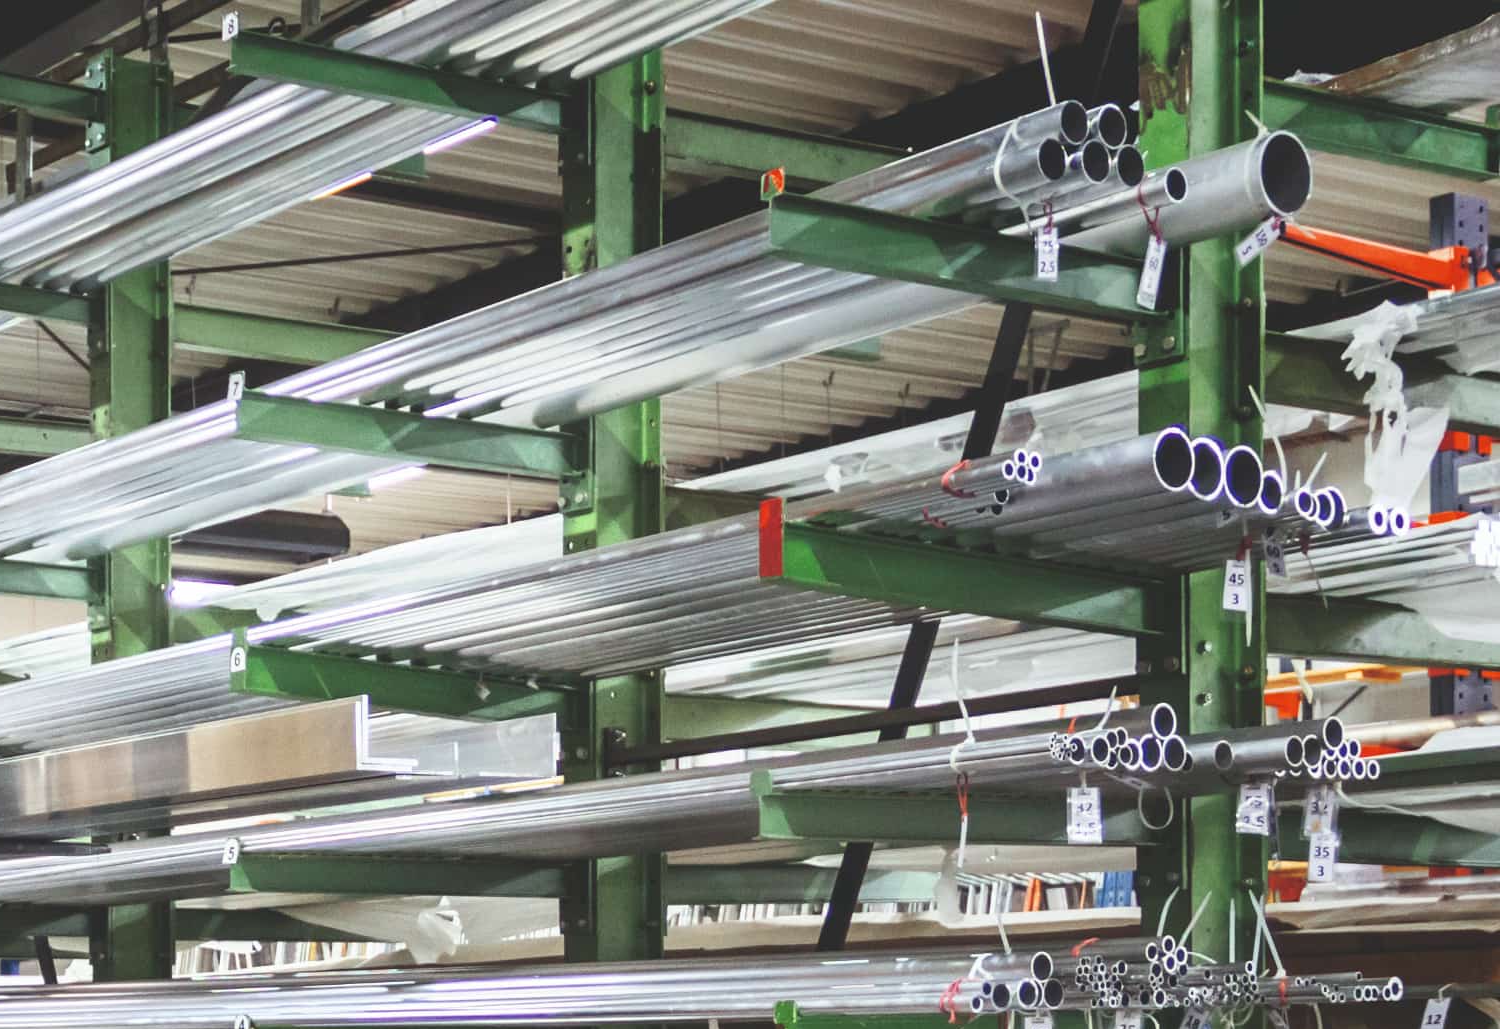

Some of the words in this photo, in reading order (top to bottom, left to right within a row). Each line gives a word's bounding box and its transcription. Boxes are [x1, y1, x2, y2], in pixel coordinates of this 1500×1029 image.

[1228, 573, 1245, 586] 45
[1232, 593, 1240, 605] 3
[233, 652, 240, 667] 6
[227, 846, 235, 861] 5
[1315, 846, 1330, 858] 35
[1316, 865, 1325, 877] 3
[1427, 1014, 1442, 1025] 12
